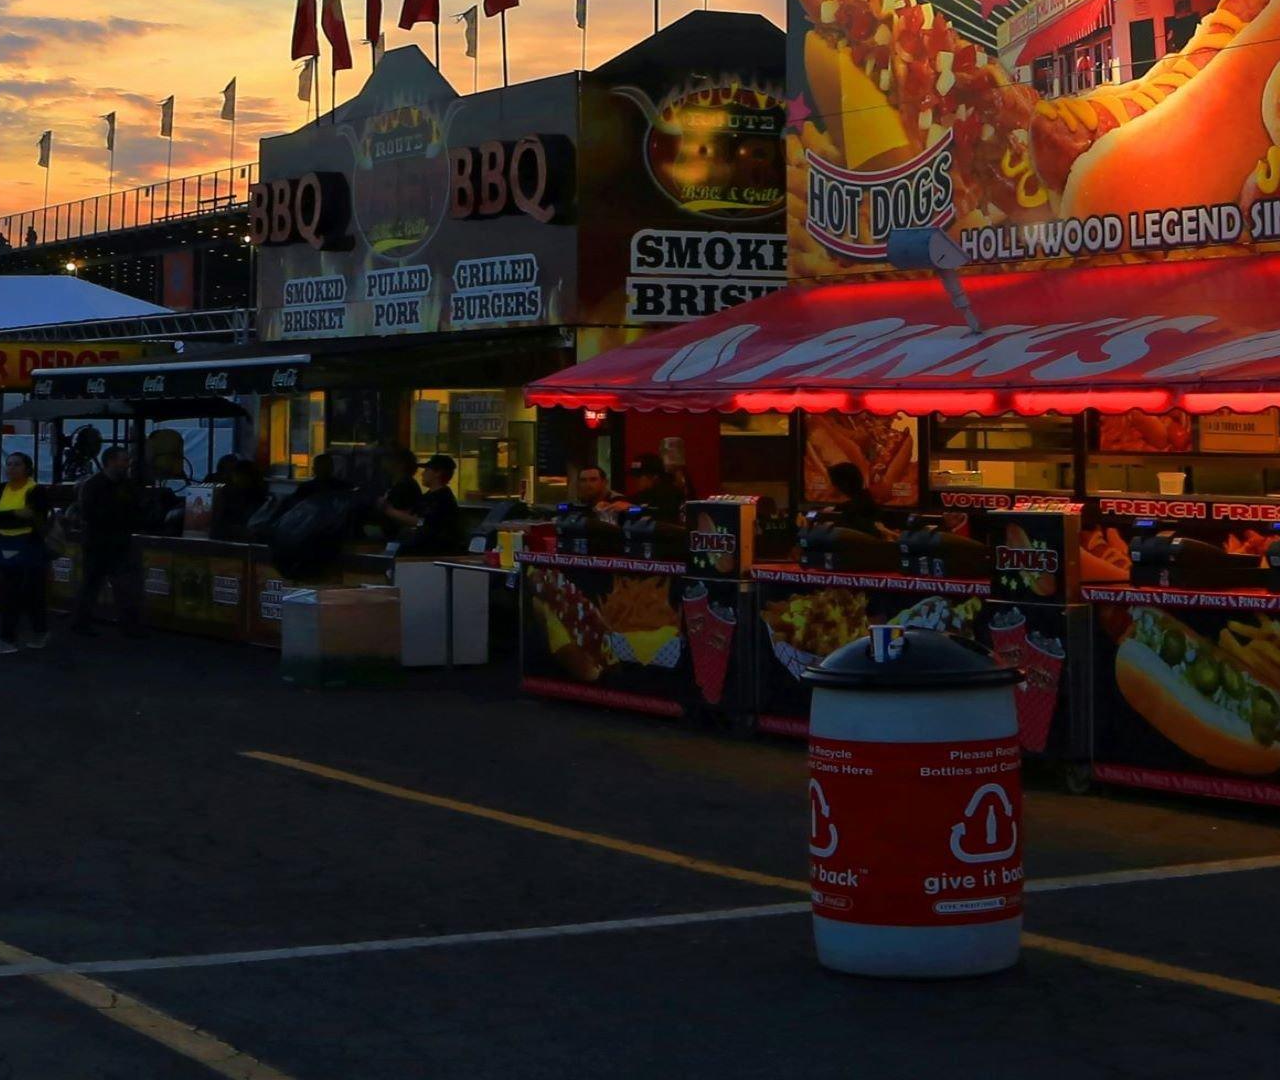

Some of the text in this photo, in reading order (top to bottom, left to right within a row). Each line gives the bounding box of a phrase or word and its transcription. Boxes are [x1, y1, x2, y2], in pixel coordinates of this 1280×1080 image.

[449, 132, 556, 224] BBQ
[808, 151, 952, 239] HOT DOGS
[249, 171, 325, 250] BBQ
[960, 214, 1122, 263] HOLLYWOOD
[1130, 204, 1242, 248] LEGEND
[366, 268, 431, 297] PULLED
[456, 257, 535, 289] GRILLED
[285, 278, 344, 305] SMOKED
[375, 299, 420, 326] PORK
[452, 290, 539, 321] BURGERS
[283, 307, 346, 332] BRISKET
[718, 315, 1218, 383] PINK'S
[940, 492, 1011, 509] VOTED
[1099, 499, 1206, 519] FRENCH
[689, 531, 736, 553] PINK'S
[996, 546, 1058, 572] PINK'S
[817, 760, 839, 773] Cans
[841, 763, 873, 776] Here
[950, 749, 993, 761] Please
[920, 767, 972, 777] Bottles
[975, 763, 997, 774] and
[924, 873, 976, 895] give
[983, 867, 997, 887] it
